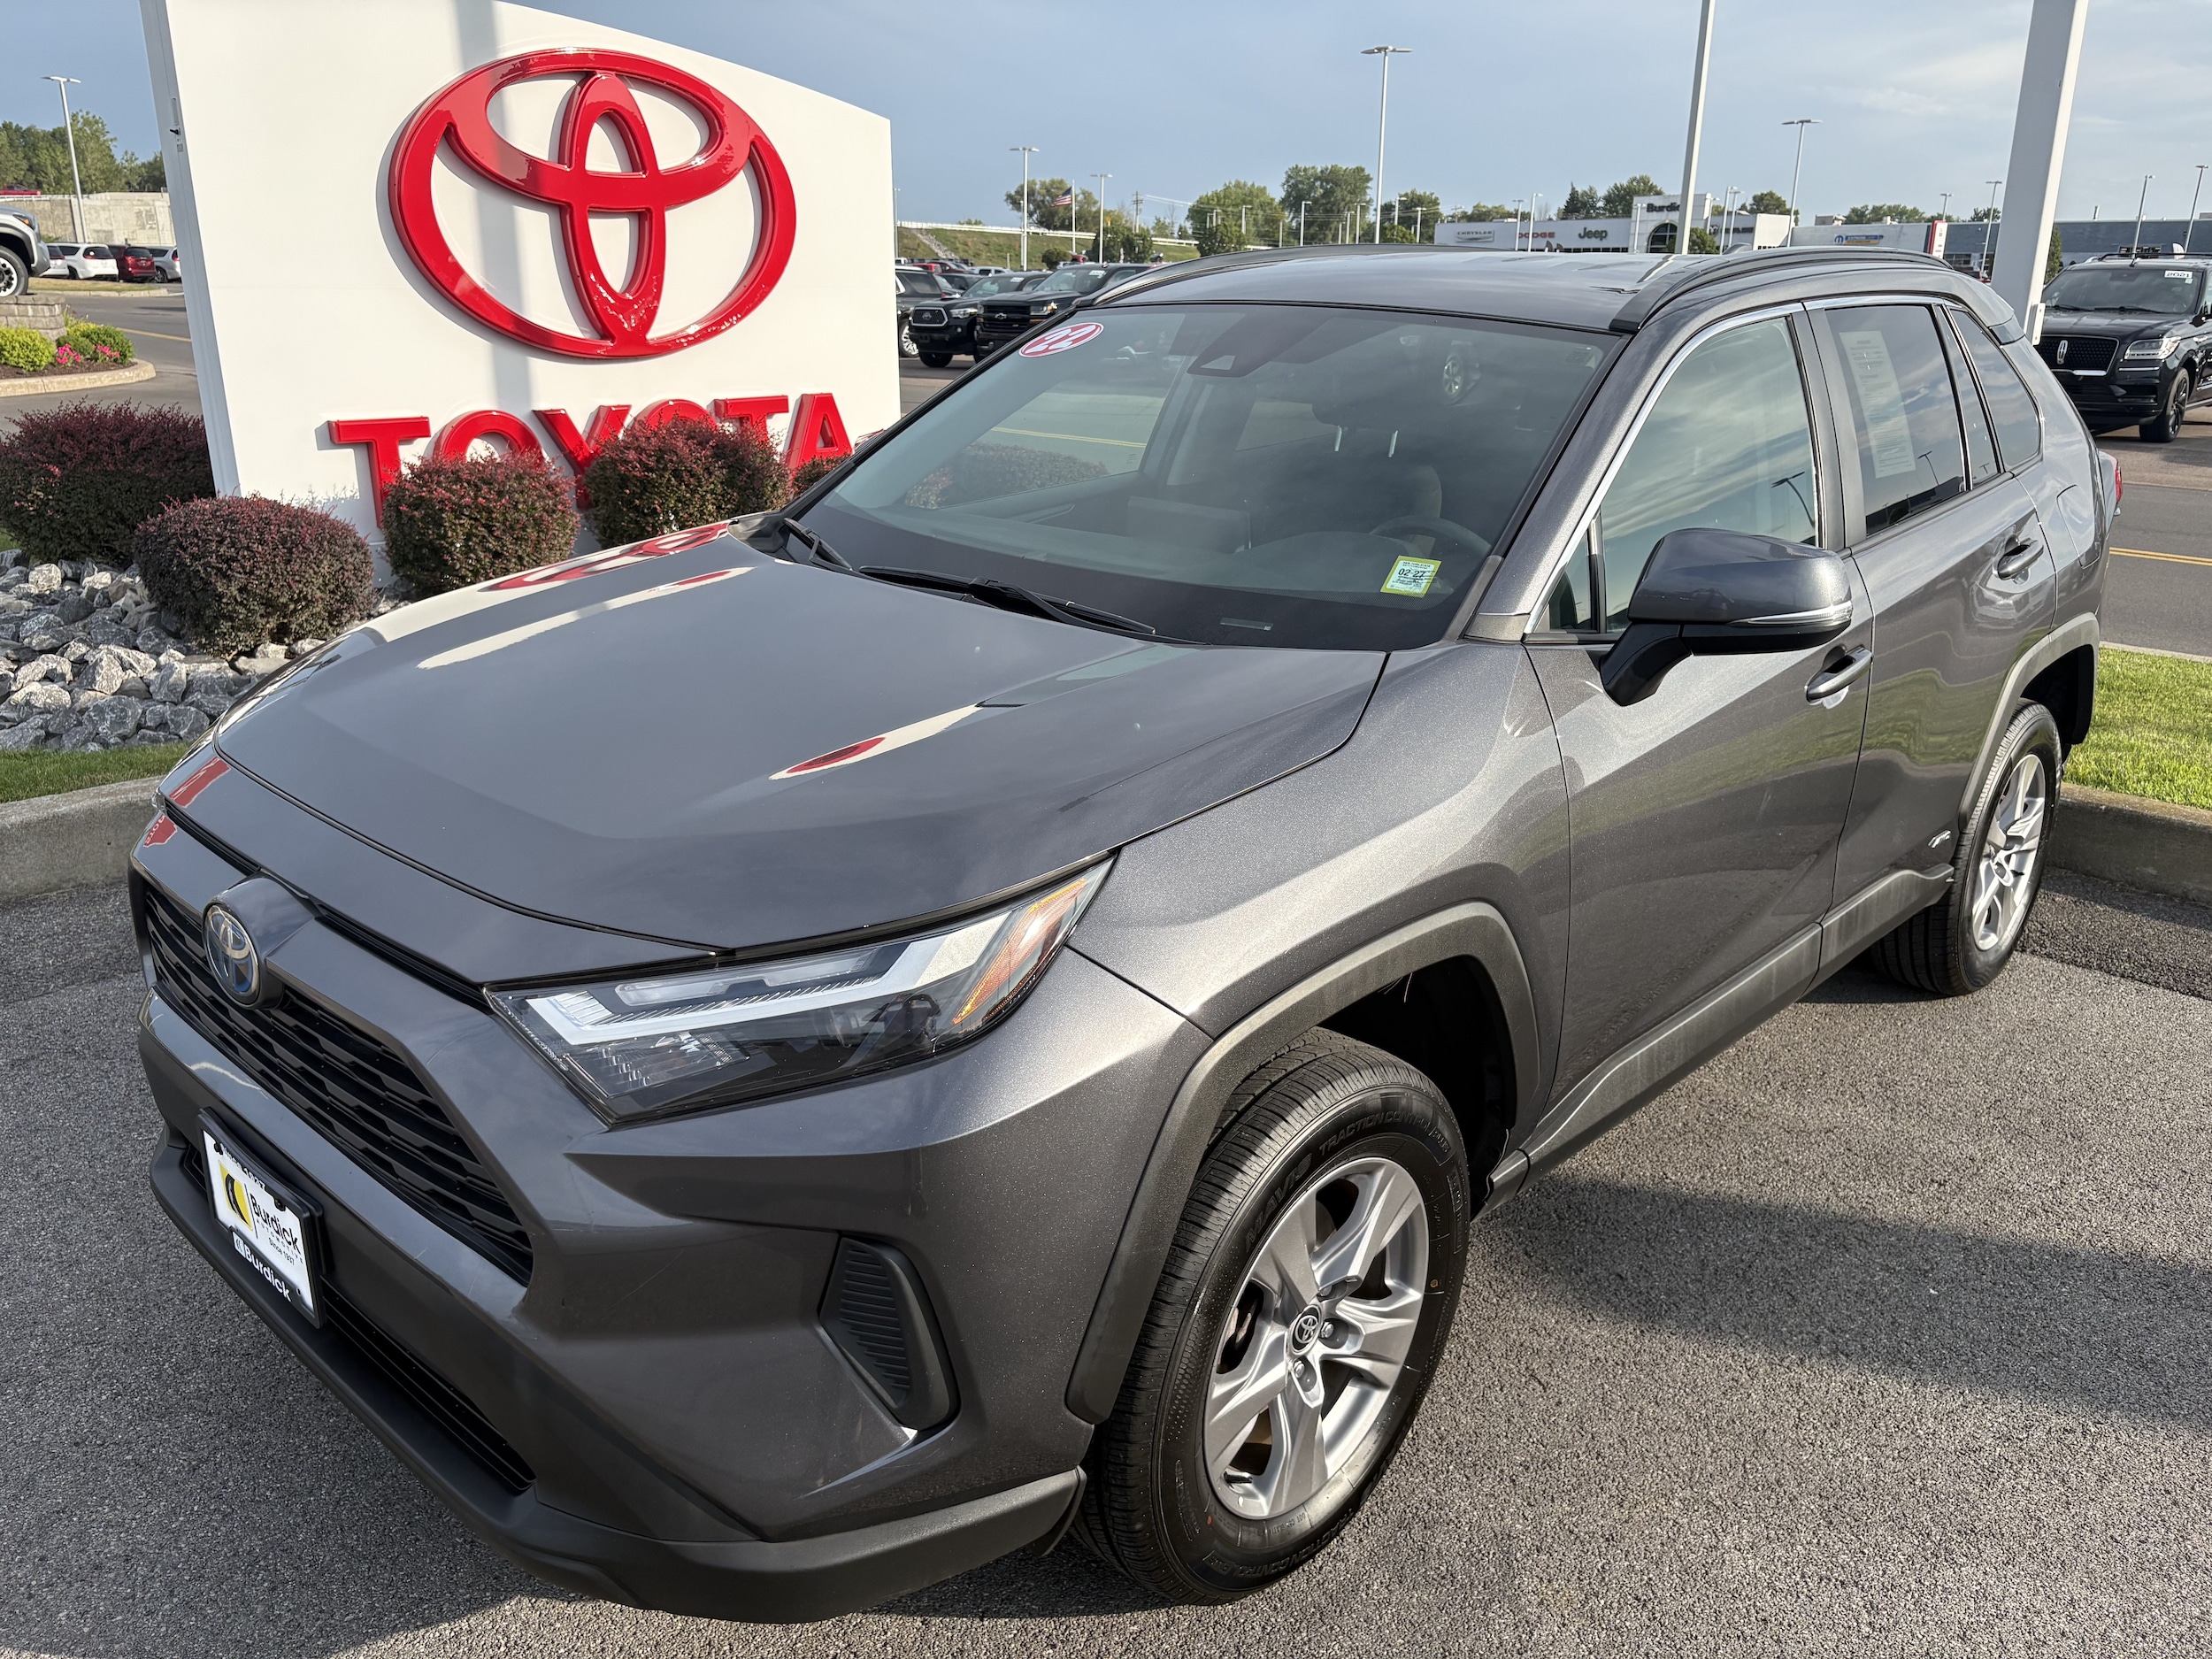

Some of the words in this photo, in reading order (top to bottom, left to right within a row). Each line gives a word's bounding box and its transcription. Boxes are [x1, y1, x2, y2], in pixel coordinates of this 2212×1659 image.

[1578, 227, 1609, 241] Jeep
[250, 1193, 302, 1255] Burdick
[244, 1243, 293, 1302] Burdick
